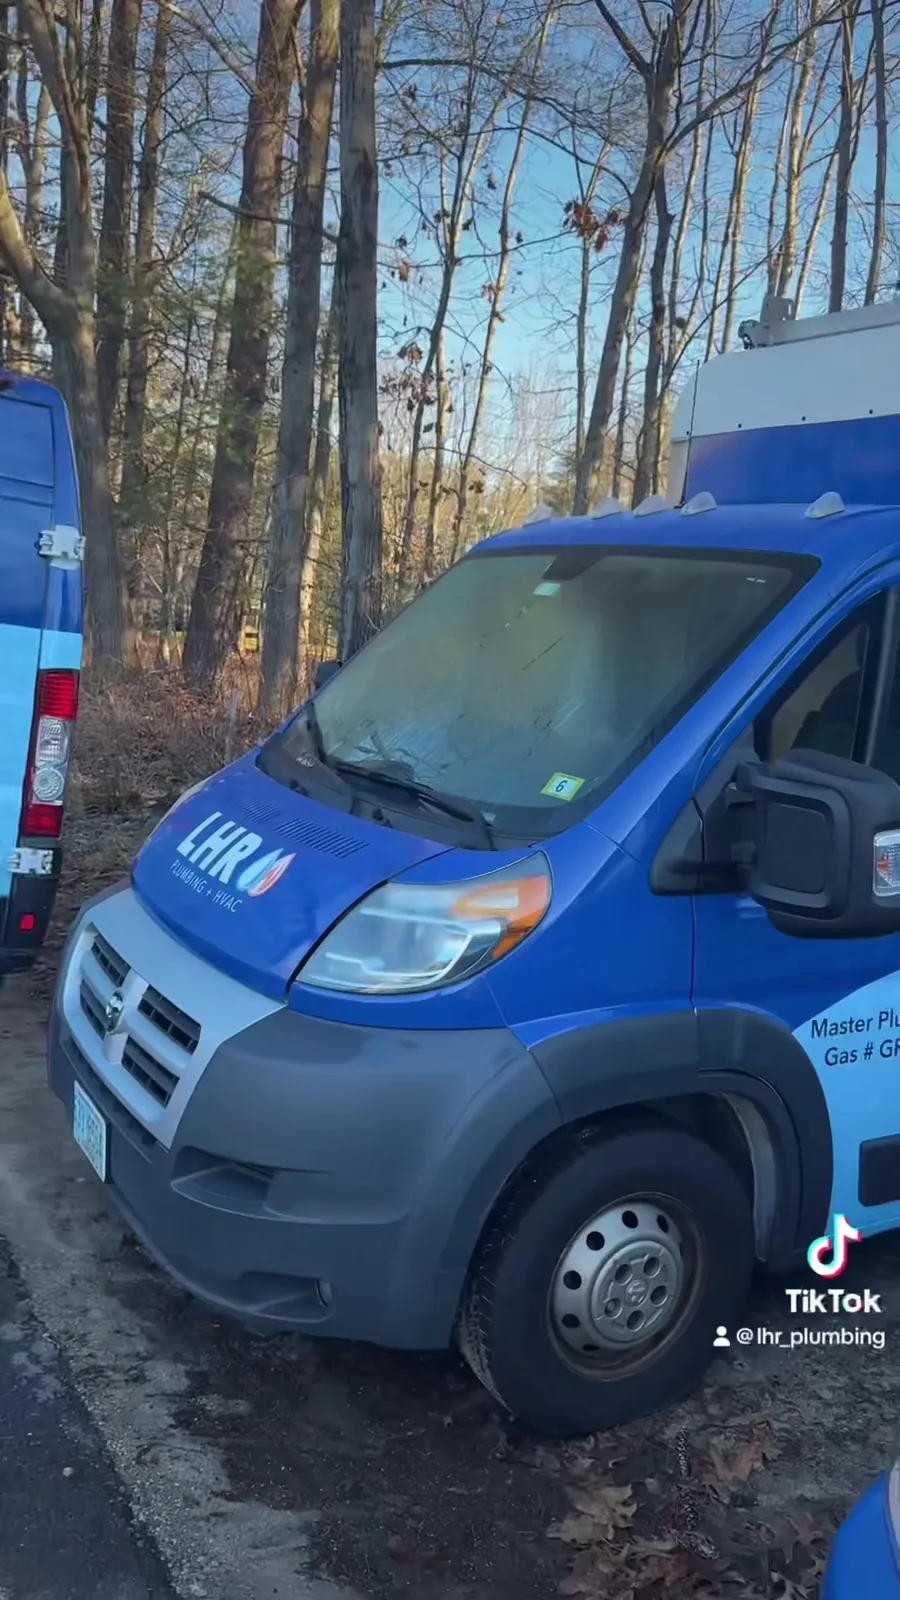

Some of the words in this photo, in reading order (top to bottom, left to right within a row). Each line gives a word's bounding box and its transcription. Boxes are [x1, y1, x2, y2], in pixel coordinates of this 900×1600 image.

[555, 780, 568, 793] 6
[176, 811, 263, 884] LHR
[170, 859, 207, 893] PLUMBING
[212, 890, 243, 912] HVAC
[811, 1017, 874, 1039] Master
[824, 1047, 858, 1066] Gas
[863, 1041, 874, 1060] #
